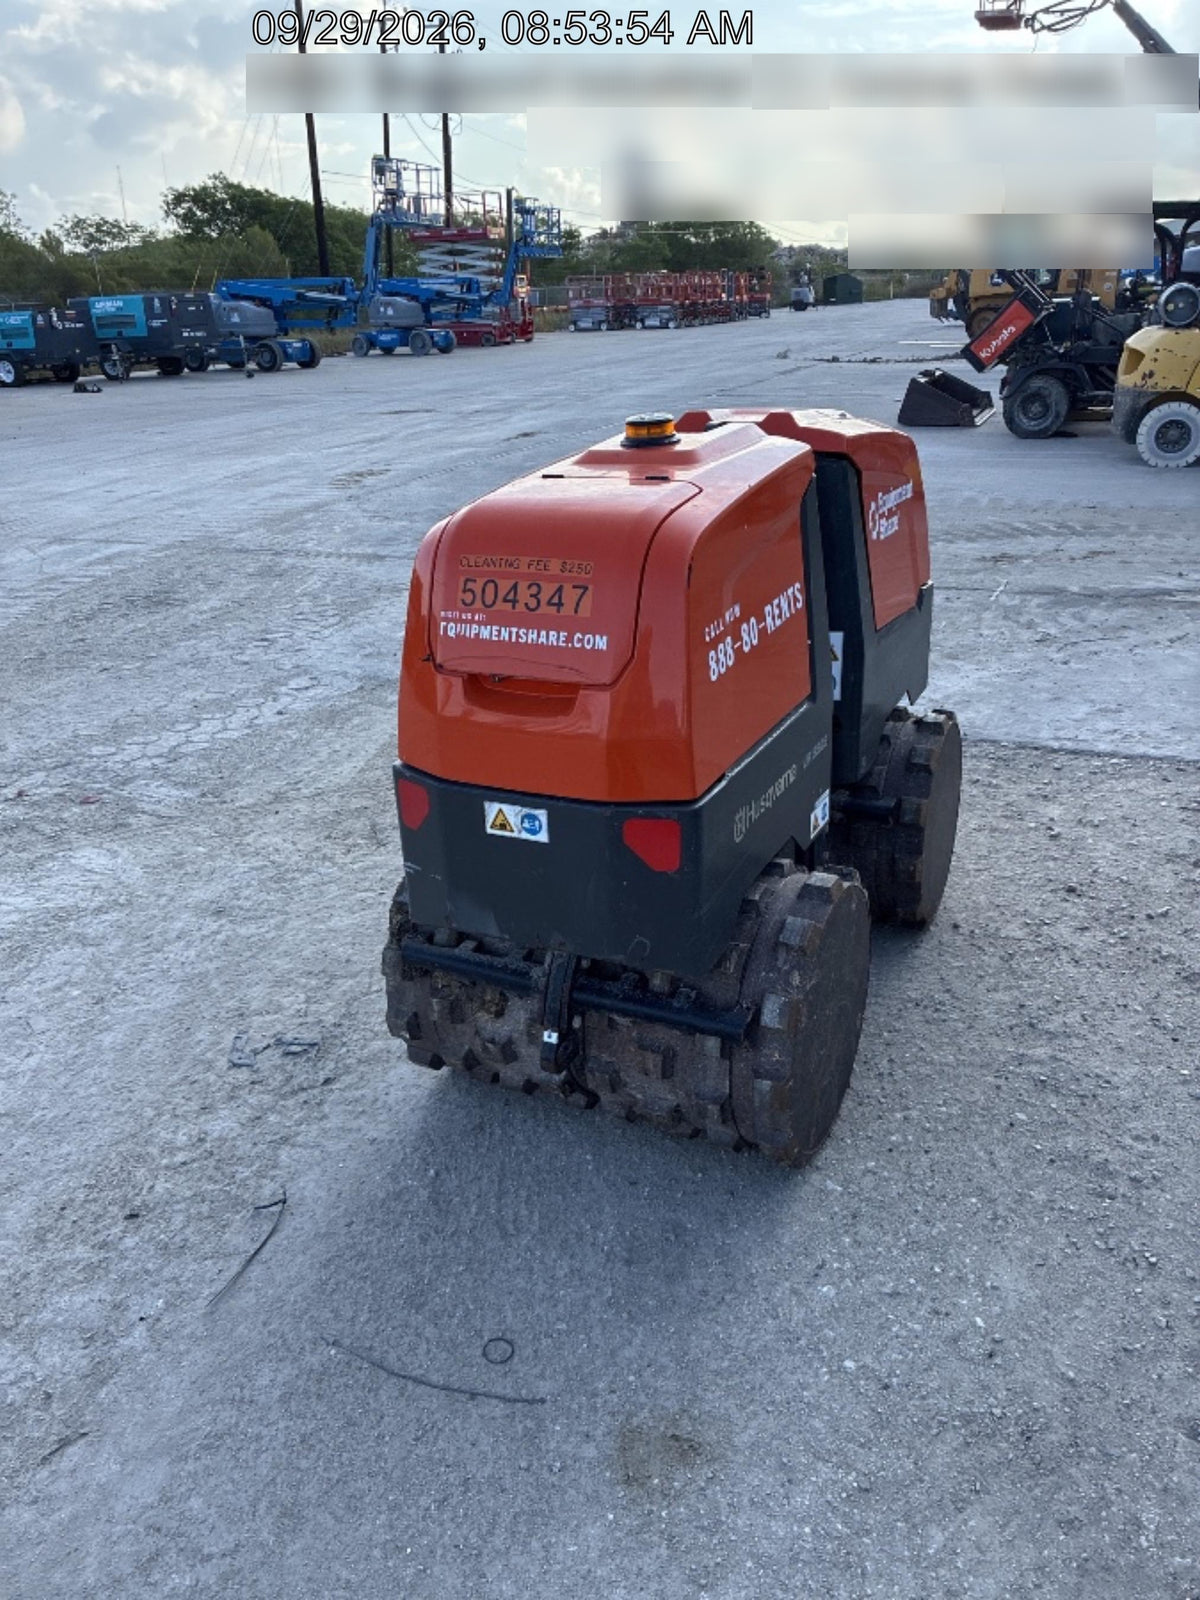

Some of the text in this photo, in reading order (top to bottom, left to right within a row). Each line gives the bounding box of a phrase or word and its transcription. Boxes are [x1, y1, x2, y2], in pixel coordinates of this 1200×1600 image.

[460, 556, 592, 575] CLEANING FEE $250
[460, 578, 589, 614] 504347
[709, 582, 803, 682] 888-80-RENTS
